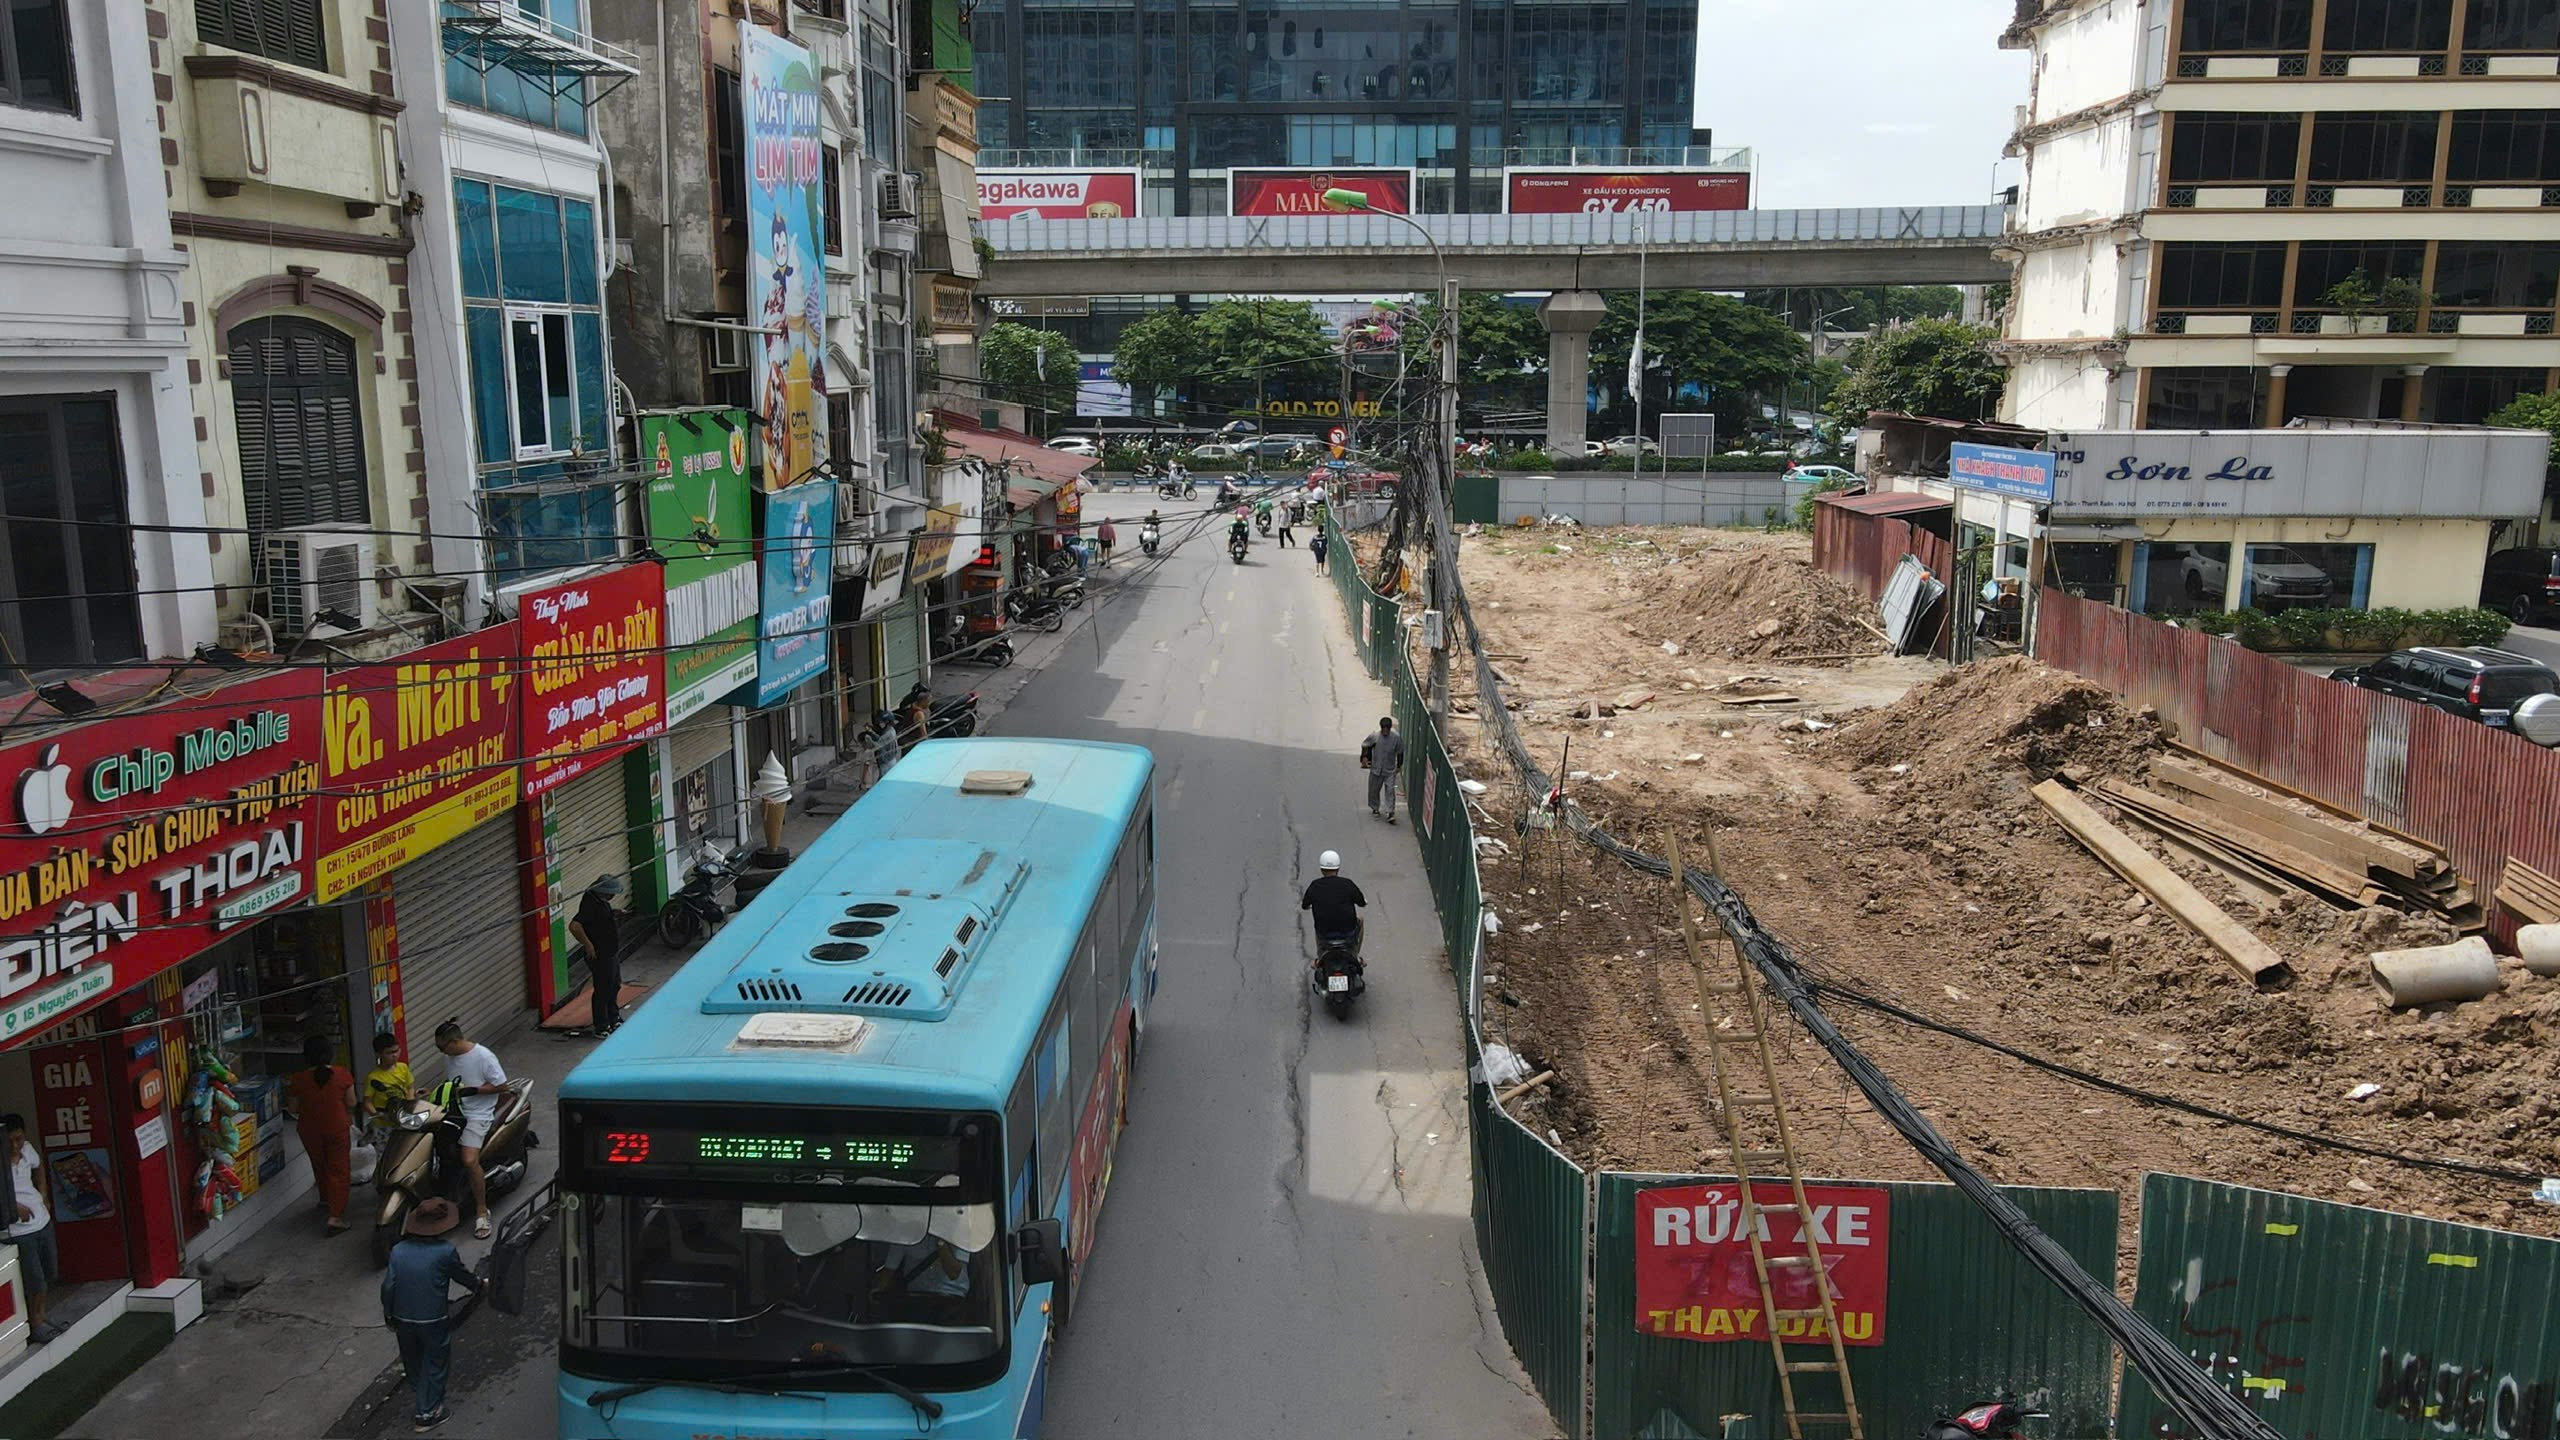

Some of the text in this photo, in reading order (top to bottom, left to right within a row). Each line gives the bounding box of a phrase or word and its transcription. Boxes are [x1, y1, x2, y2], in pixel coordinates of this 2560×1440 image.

[1583, 198, 1671, 213] GX 450
[1629, 187, 1671, 195] DONGFENG
[1956, 456, 1970, 473] NHÀ
[1996, 463, 2021, 481] THANH
[2022, 464, 2046, 485] XUÂN
[2106, 456, 2274, 480] Sơn La
[807, 594, 831, 623] CITY
[324, 684, 384, 778] Va.
[397, 646, 481, 752] Mart
[92, 710, 290, 803] Chip Mobile
[337, 782, 378, 834] CỬA
[382, 769, 433, 814] HÀNG
[437, 746, 473, 788] TIỆN
[477, 736, 504, 772] ÍCH
[39, 846, 89, 906] BÁN
[111, 820, 159, 875] SỬA
[164, 798, 220, 854] CHỮA
[237, 782, 274, 823] PHỤ
[279, 759, 320, 810] KIỆN
[327, 857, 345, 875] CH1:
[328, 879, 345, 896] CH2:
[358, 857, 387, 883] NGUYỄN
[0, 891, 139, 999] ĐIỆN
[160, 820, 304, 920] THOẠI
[238, 879, 297, 917] 0869 555 218
[23, 974, 105, 1023] 18 Nguyễn Tuân
[43, 1053, 93, 1090] GIÁ
[55, 1096, 92, 1133] RẺ
[1653, 1190, 1871, 1247] RỬA XE
[1648, 1305, 1760, 1336] THAY
